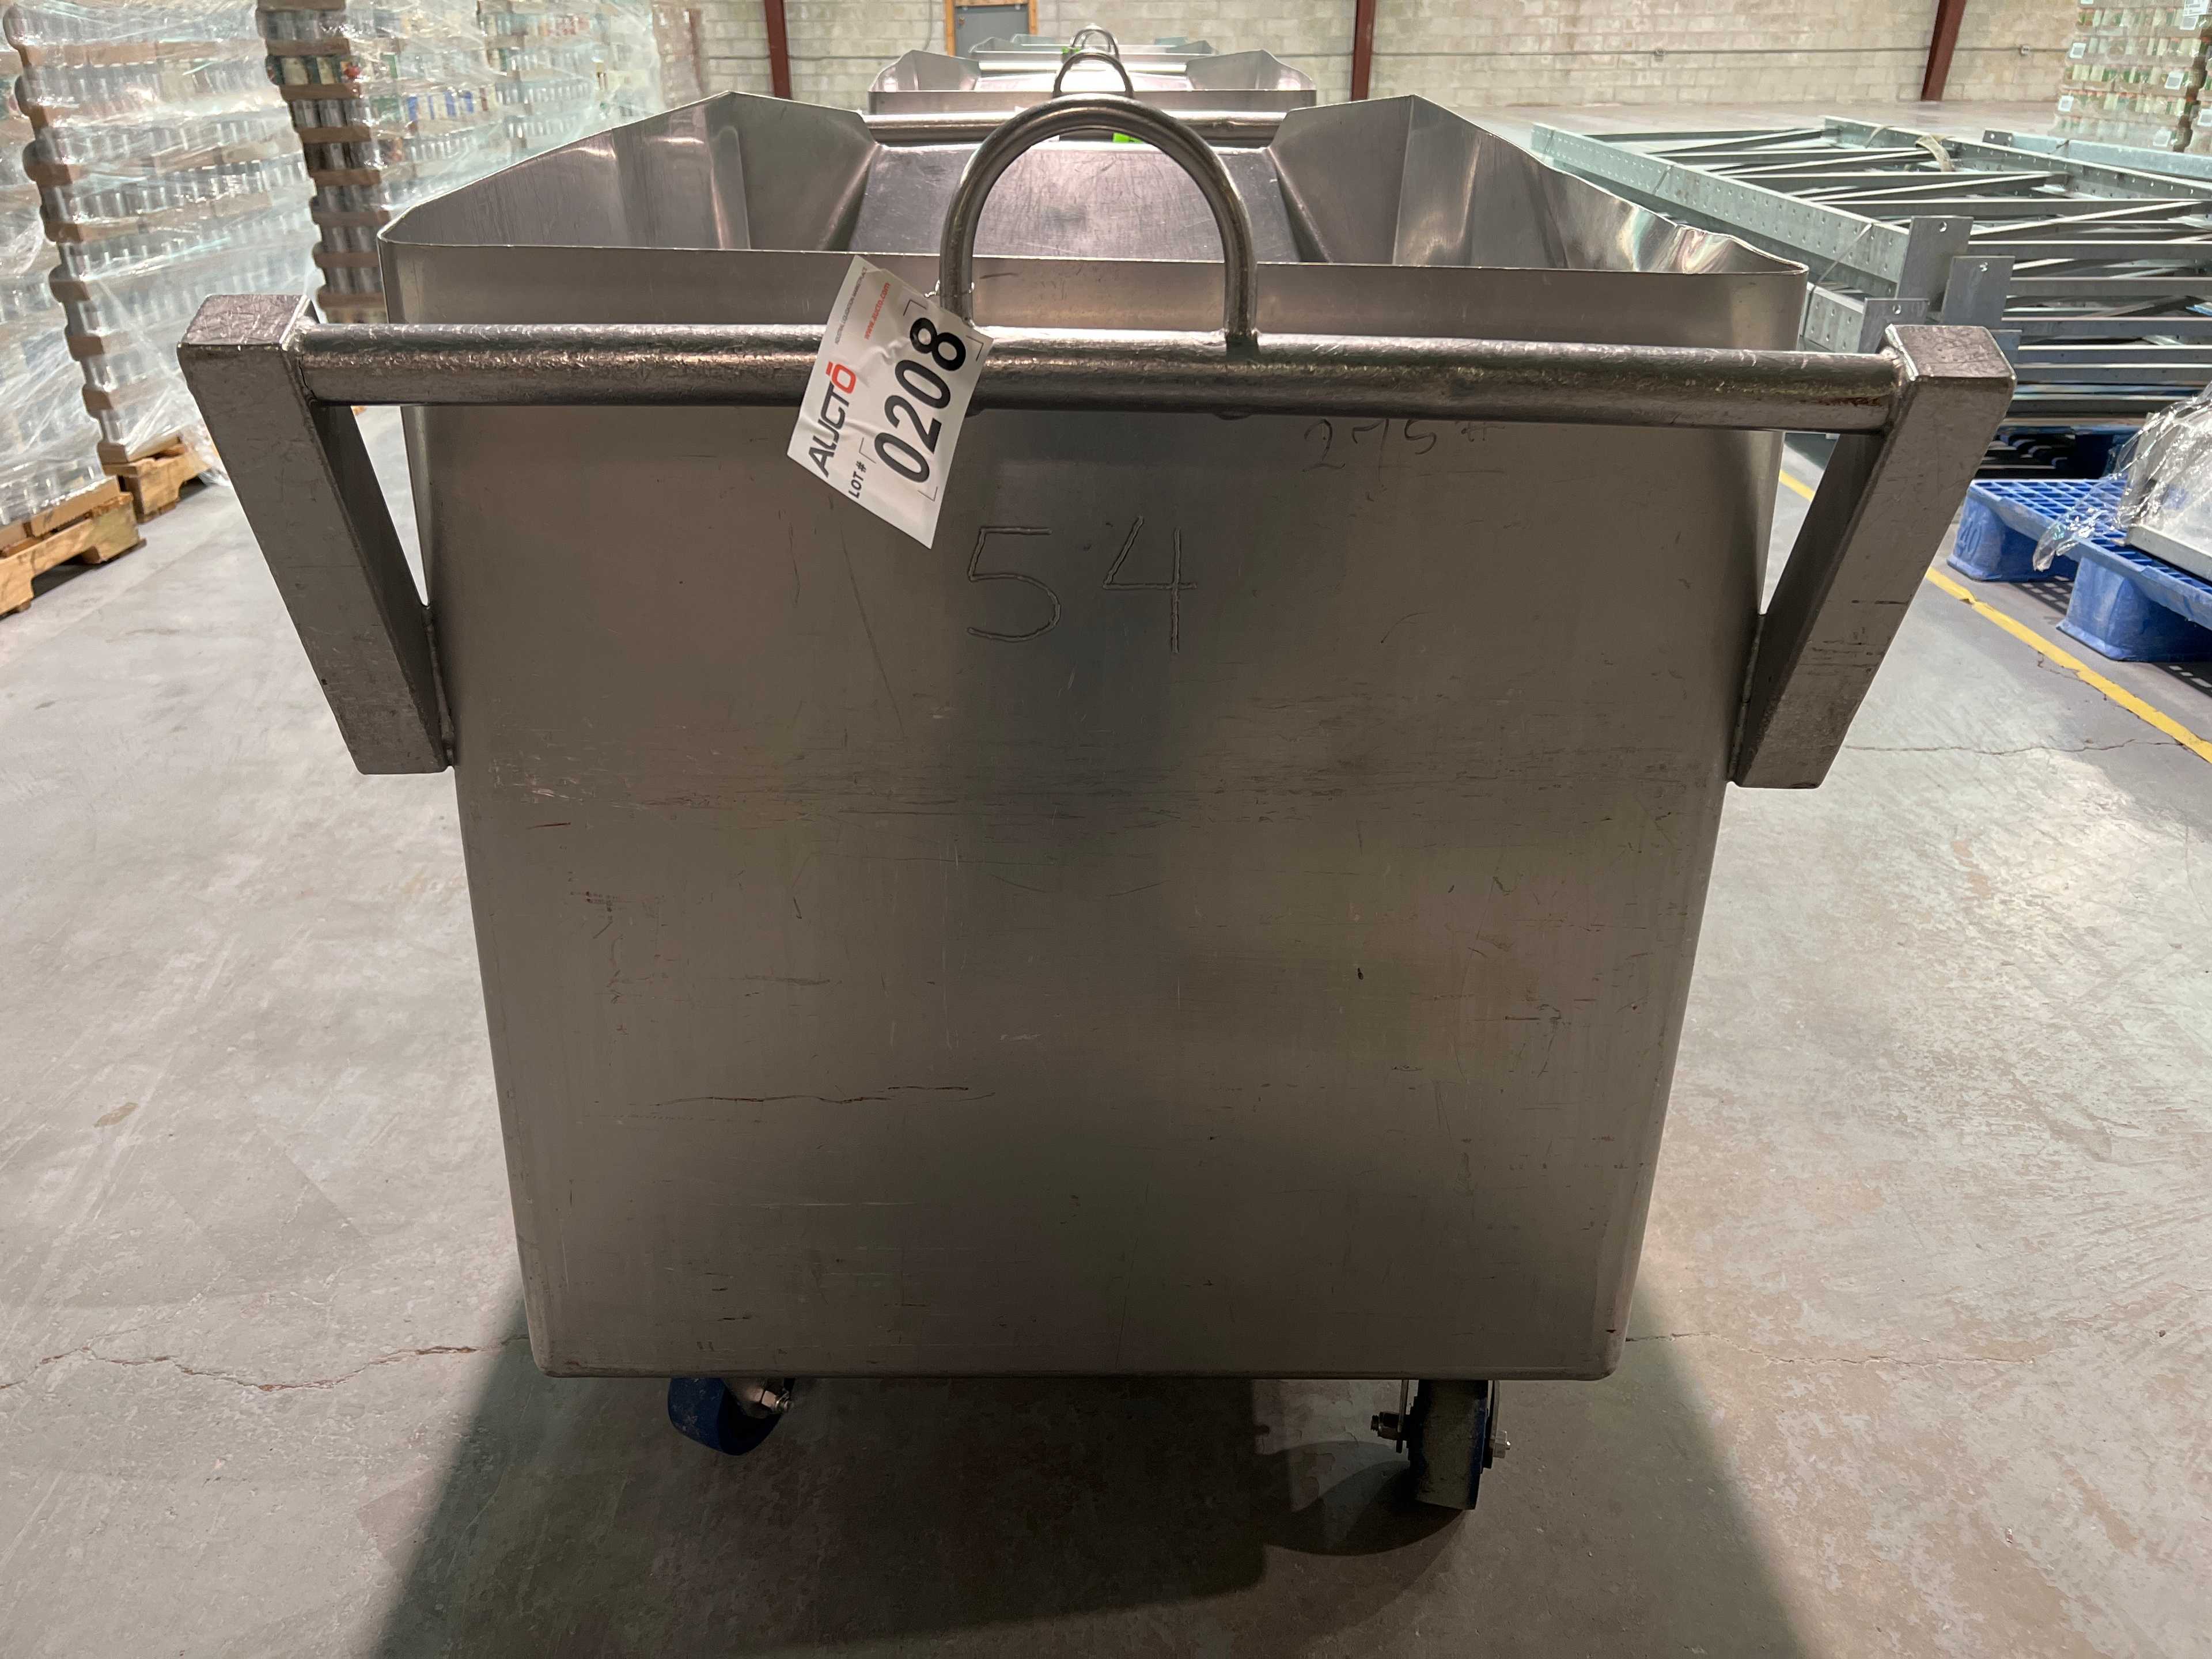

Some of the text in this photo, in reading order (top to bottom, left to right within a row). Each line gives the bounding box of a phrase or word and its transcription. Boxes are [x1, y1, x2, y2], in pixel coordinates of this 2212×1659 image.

[865, 282, 891, 340] www.aucto.com
[874, 317, 966, 483] 0208
[848, 460, 868, 498] LOT #
